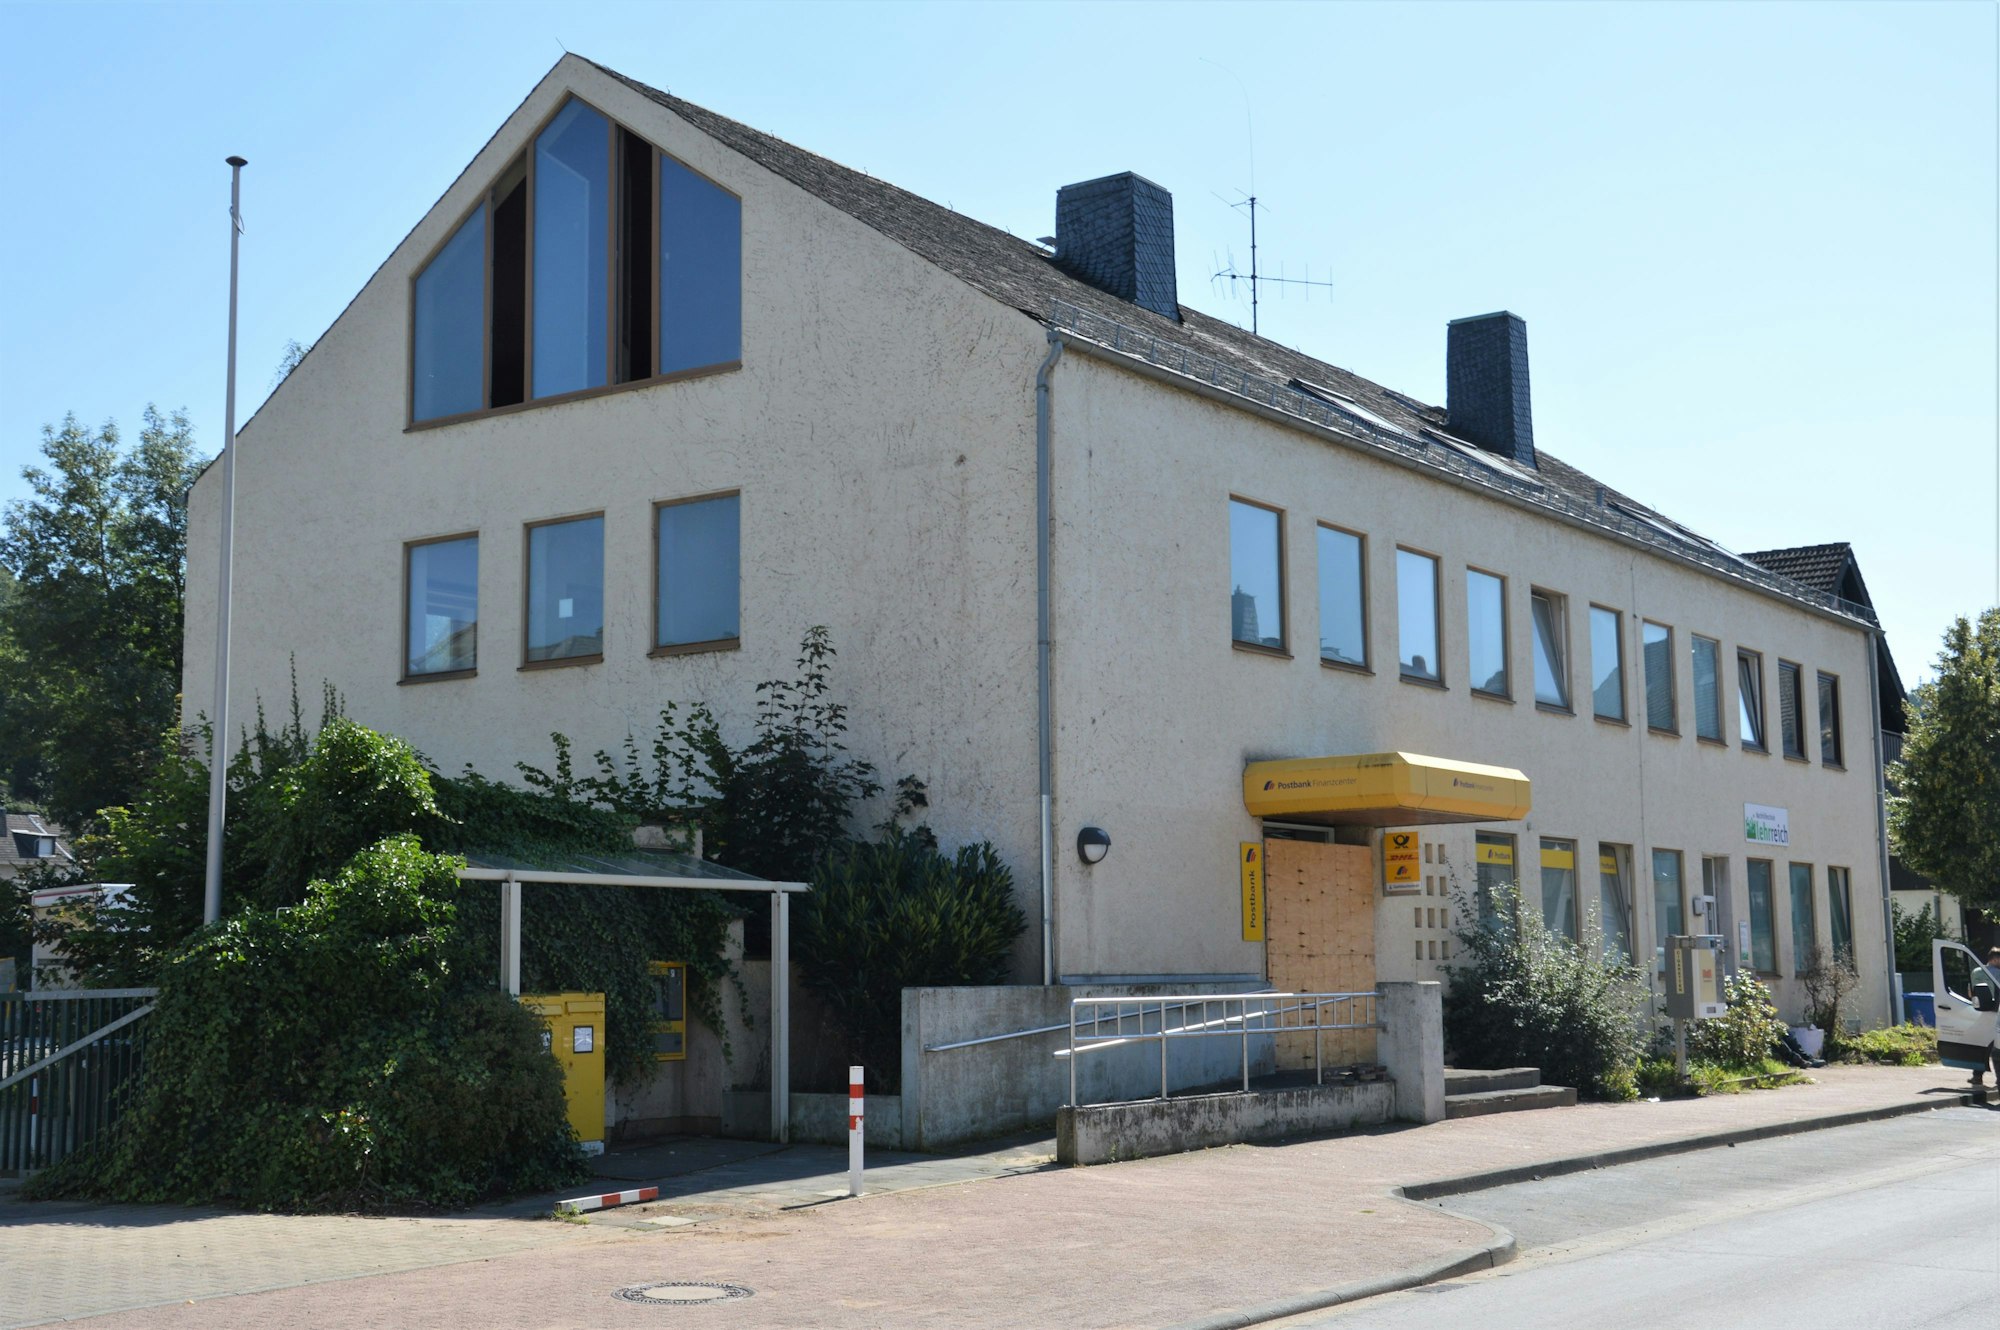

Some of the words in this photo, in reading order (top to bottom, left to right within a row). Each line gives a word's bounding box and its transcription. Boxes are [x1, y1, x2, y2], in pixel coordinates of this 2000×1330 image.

[1278, 780, 1312, 789] Postbank
[1312, 777, 1357, 787] Finanzcenter
[1757, 821, 1789, 843] lehrreich
